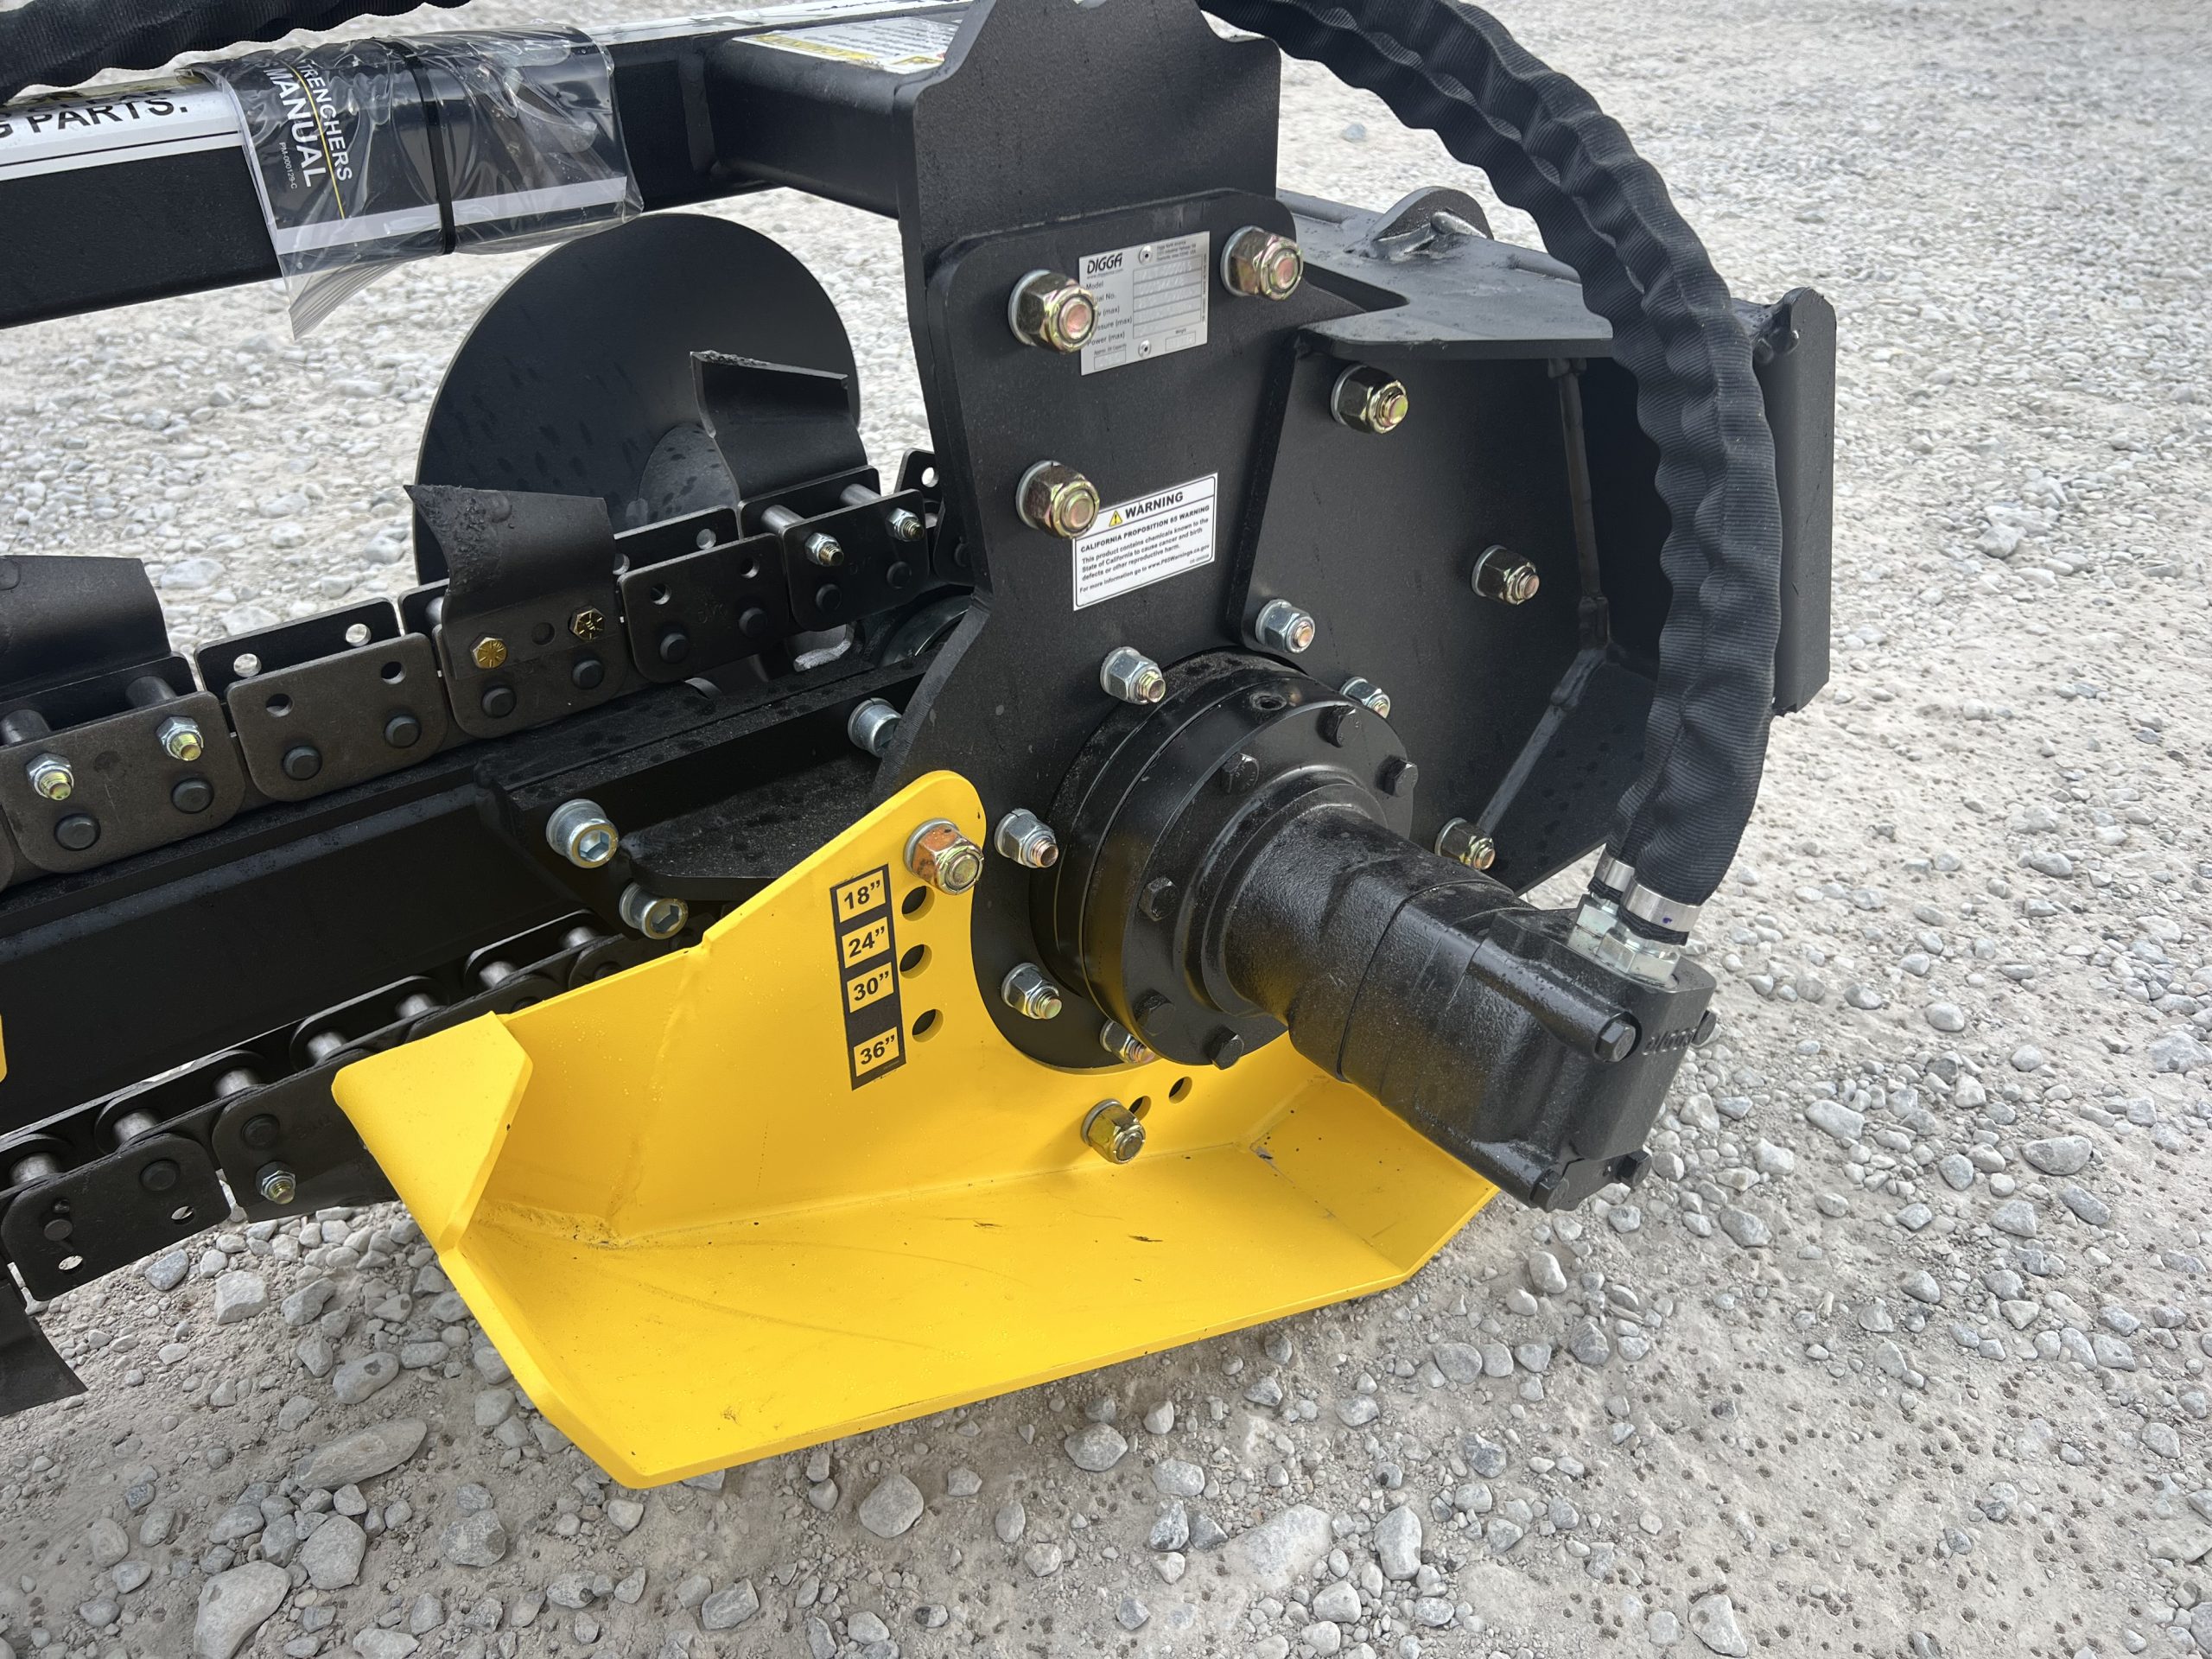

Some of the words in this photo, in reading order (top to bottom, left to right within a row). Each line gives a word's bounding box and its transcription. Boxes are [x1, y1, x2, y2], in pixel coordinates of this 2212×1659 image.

[26, 97, 188, 133] PARTS.
[263, 67, 327, 188] MANUAL
[296, 64, 353, 181] TRENCHERS
[278, 142, 298, 190] PM-000129-C
[1087, 252, 1123, 275] DIGGA
[1085, 280, 1104, 290] Model
[1125, 492, 1184, 519] WARNING
[1080, 535, 1122, 553] CALIFORNIA
[1123, 518, 1169, 539] PROPOSITION
[1179, 505, 1210, 521] WARNING
[1082, 556, 1095, 564] This
[1096, 548, 1119, 561] product
[1119, 539, 1144, 552] contains
[1145, 530, 1173, 543] chemicals
[1173, 523, 1192, 533] known
[1082, 564, 1097, 573] State
[1105, 552, 1134, 565] California
[1141, 543, 1158, 553] cause
[1159, 536, 1178, 547] cancer
[1178, 531, 1189, 541] and
[1190, 527, 1203, 537] birth
[1082, 569, 1104, 582] defects
[1112, 562, 1128, 571] other
[1128, 550, 1164, 565] reproductive
[1090, 582, 1103, 590] more
[1103, 570, 1134, 585] information
